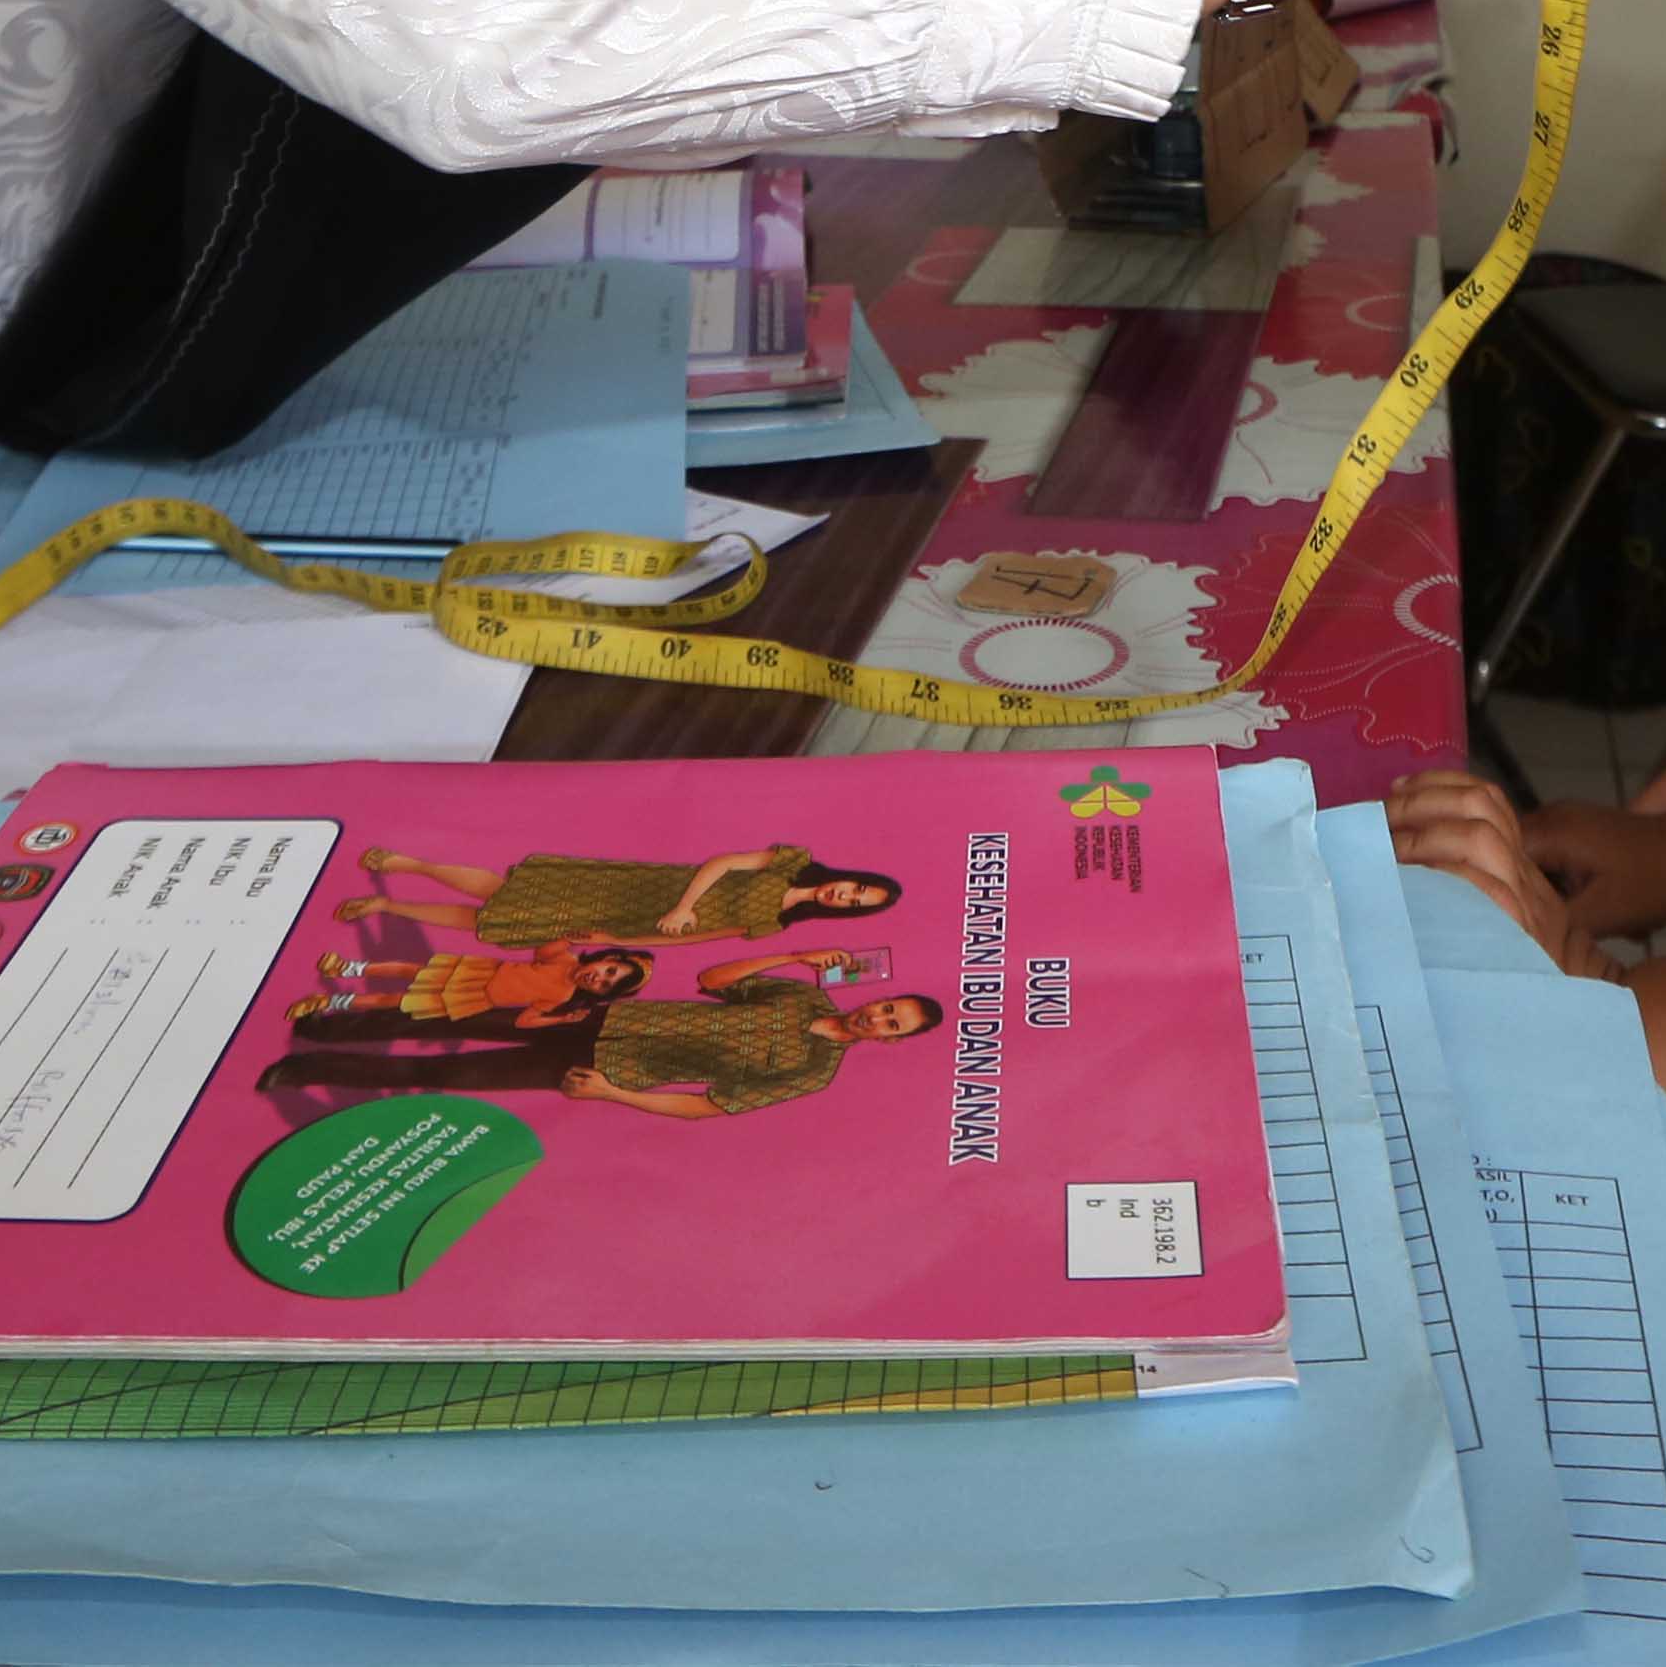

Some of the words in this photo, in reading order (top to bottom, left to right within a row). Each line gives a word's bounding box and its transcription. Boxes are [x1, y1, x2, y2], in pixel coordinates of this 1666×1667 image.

[1541, 23, 1561, 58] 26
[1534, 110, 1551, 146] 27
[1508, 198, 1529, 232] 28
[1455, 278, 1485, 309] 29
[1400, 353, 1428, 388] 30
[1348, 434, 1377, 467] 31
[1310, 517, 1333, 553] 32
[475, 617, 509, 639] 42
[571, 628, 603, 649] 41
[660, 638, 692, 660] 40
[746, 645, 779, 668] 39
[828, 662, 855, 687] 38
[911, 678, 940, 703] 37
[998, 693, 1032, 711] 36
[136, 836, 162, 861] NIK
[168, 836, 205, 876] Nama
[225, 836, 252, 862] NIK
[261, 836, 294, 875] Nama
[108, 863, 144, 899] Anak
[146, 874, 181, 911] Anak
[209, 863, 235, 887] Ibu
[246, 875, 274, 898] Ibu
[961, 832, 1009, 967] KESEHATAN
[959, 972, 1004, 1015] IBU
[1026, 958, 1070, 1028] BUKU
[955, 1018, 1002, 1076] DAN
[443, 1123, 490, 1159] BAWA
[949, 1080, 1000, 1166] ANAK
[341, 1135, 381, 1167] DAN
[350, 1112, 443, 1178] POSYANDU,
[387, 1123, 459, 1179] FASILITAS
[295, 1163, 343, 1200] PAUD
[403, 1157, 449, 1192] BUKU
[290, 1177, 391, 1250] KESEHATAN,
[302, 1178, 356, 1219] KELAS
[377, 1189, 407, 1213] INI
[1086, 1198, 1106, 1209] b
[1118, 1198, 1141, 1220] Ind
[1554, 1192, 1590, 1207] KET
[267, 1216, 307, 1243] IBU,
[327, 1209, 381, 1255] SETIAP
[1151, 1198, 1178, 1265] 362.198.2
[299, 1252, 327, 1276] KE
